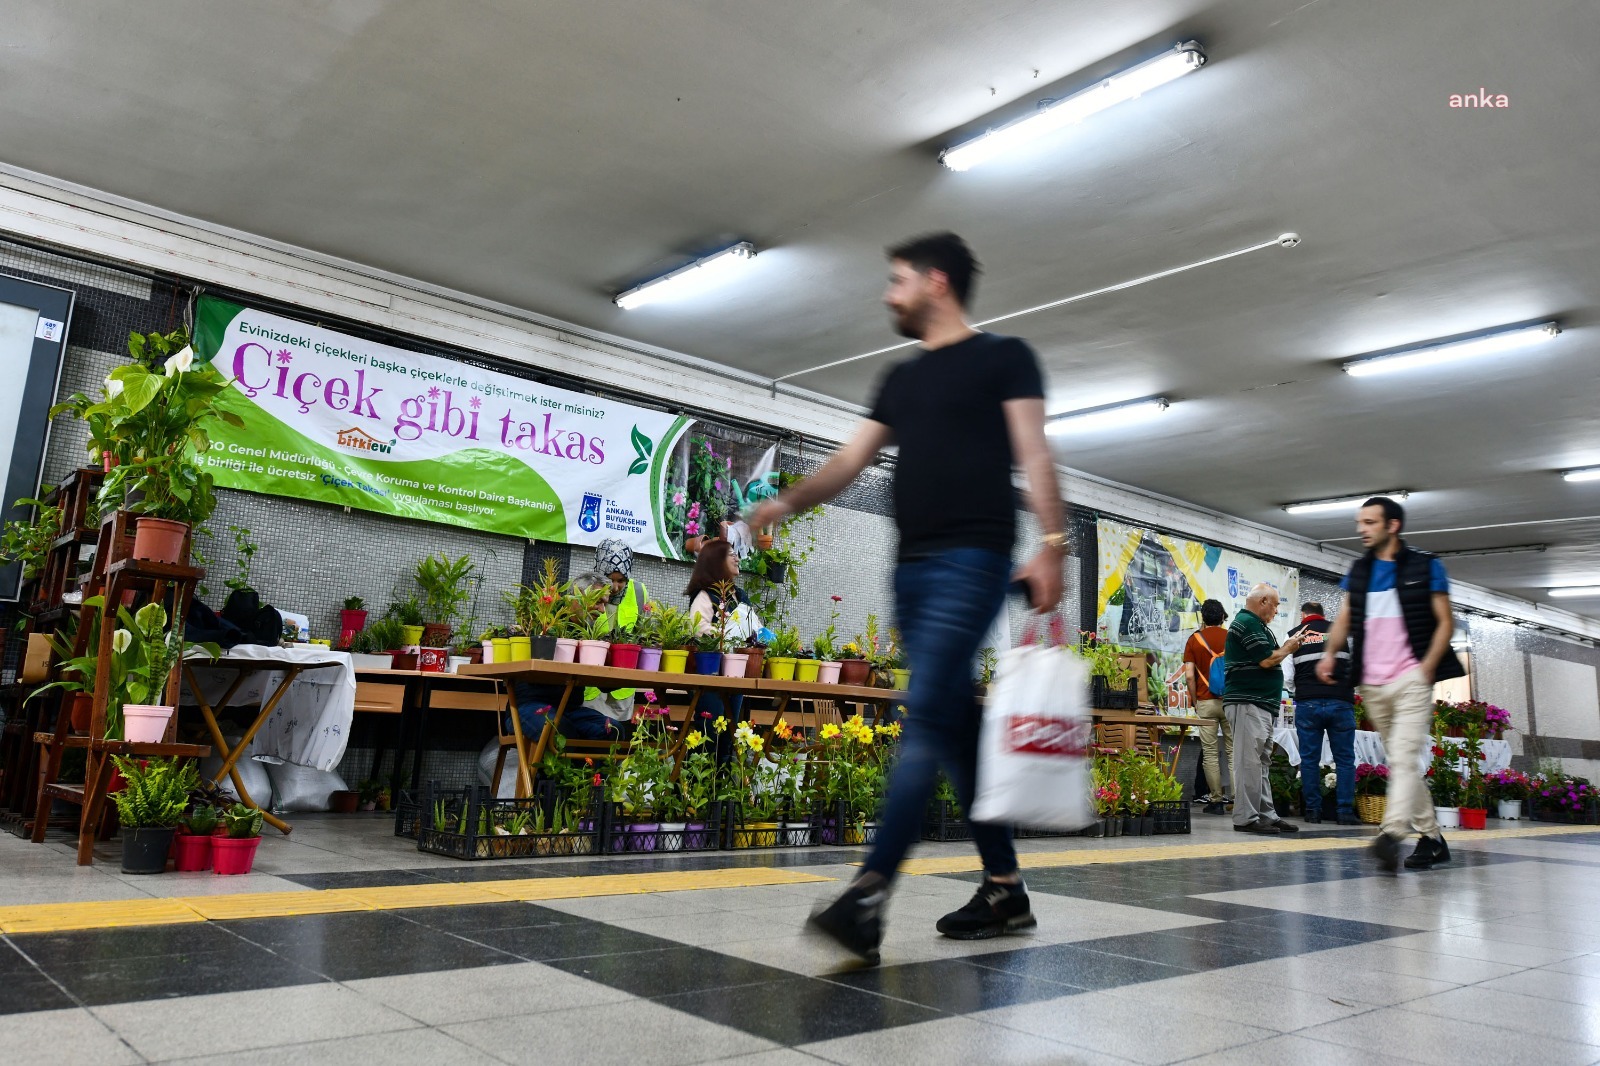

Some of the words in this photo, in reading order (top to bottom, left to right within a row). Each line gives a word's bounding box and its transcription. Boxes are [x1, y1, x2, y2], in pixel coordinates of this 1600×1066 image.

[239, 321, 311, 349] Evinizdeki
[314, 342, 367, 365] çiçekleri
[370, 356, 407, 374] başka
[410, 367, 468, 388] çiçeklerle
[471, 380, 537, 405] değiştirmek
[540, 396, 562, 410] ister
[564, 403, 605, 420] misiniz?
[232, 343, 383, 420] Çiçek
[394, 385, 482, 441] gibi
[499, 408, 605, 465] takas
[337, 431, 392, 454] bitkievi
[207, 455, 245, 472] birliği
[248, 462, 264, 473] ile
[267, 464, 317, 482] ücretsiz
[392, 492, 453, 508] uygulaması
[455, 501, 497, 516] başlıyor.
[228, 443, 266, 458] Genel
[269, 449, 336, 470] Müdürlüğü
[344, 465, 373, 480] Çevre
[376, 473, 420, 488] Koruma
[422, 483, 435, 491] ve
[438, 484, 476, 498] Kontrol
[479, 490, 505, 503] Daire
[507, 495, 556, 513] Başkanlığı
[606, 499, 617, 507] T.C.
[605, 507, 634, 517] ANKARA
